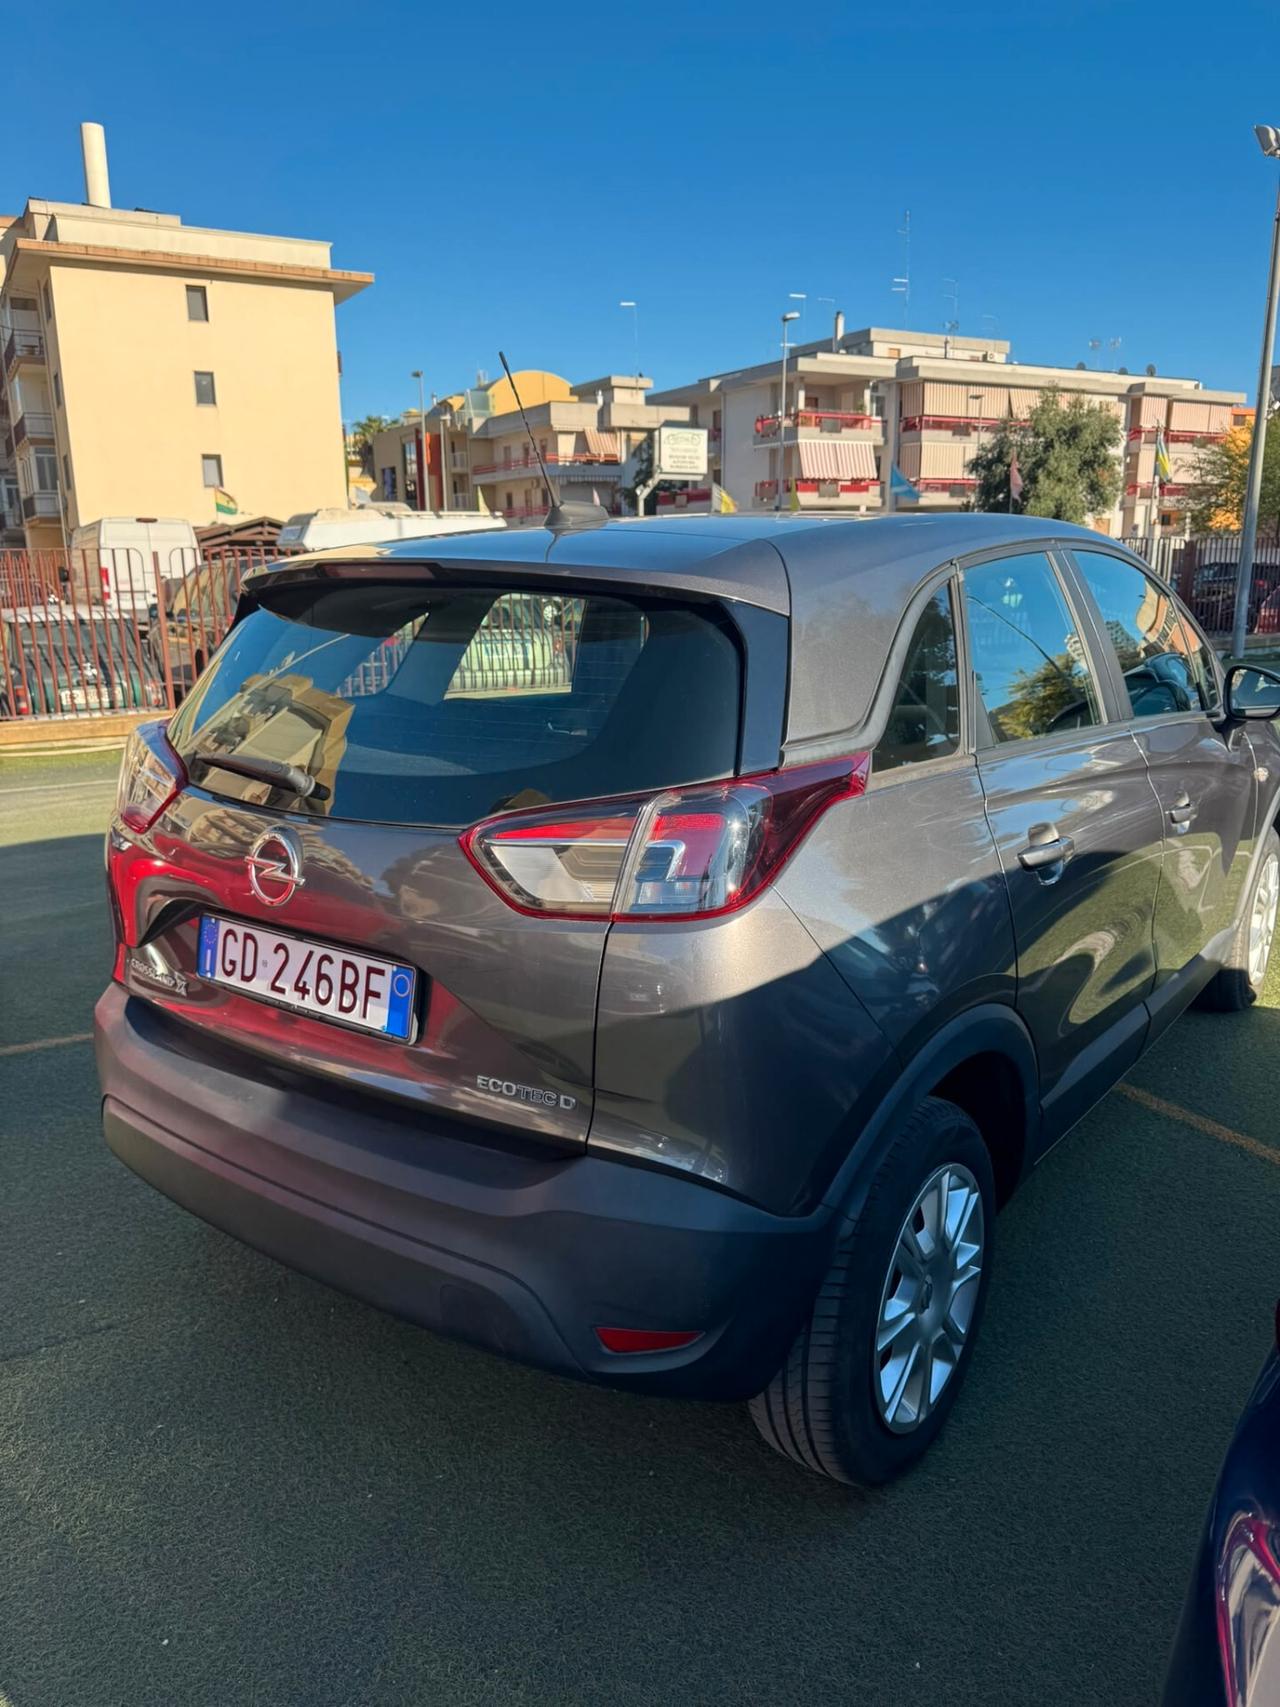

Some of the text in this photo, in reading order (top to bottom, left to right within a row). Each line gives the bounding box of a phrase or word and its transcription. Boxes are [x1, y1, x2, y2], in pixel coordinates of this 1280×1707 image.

[221, 928, 386, 1019] GD 246BF
[476, 1075, 576, 1110] ECOTEC D
